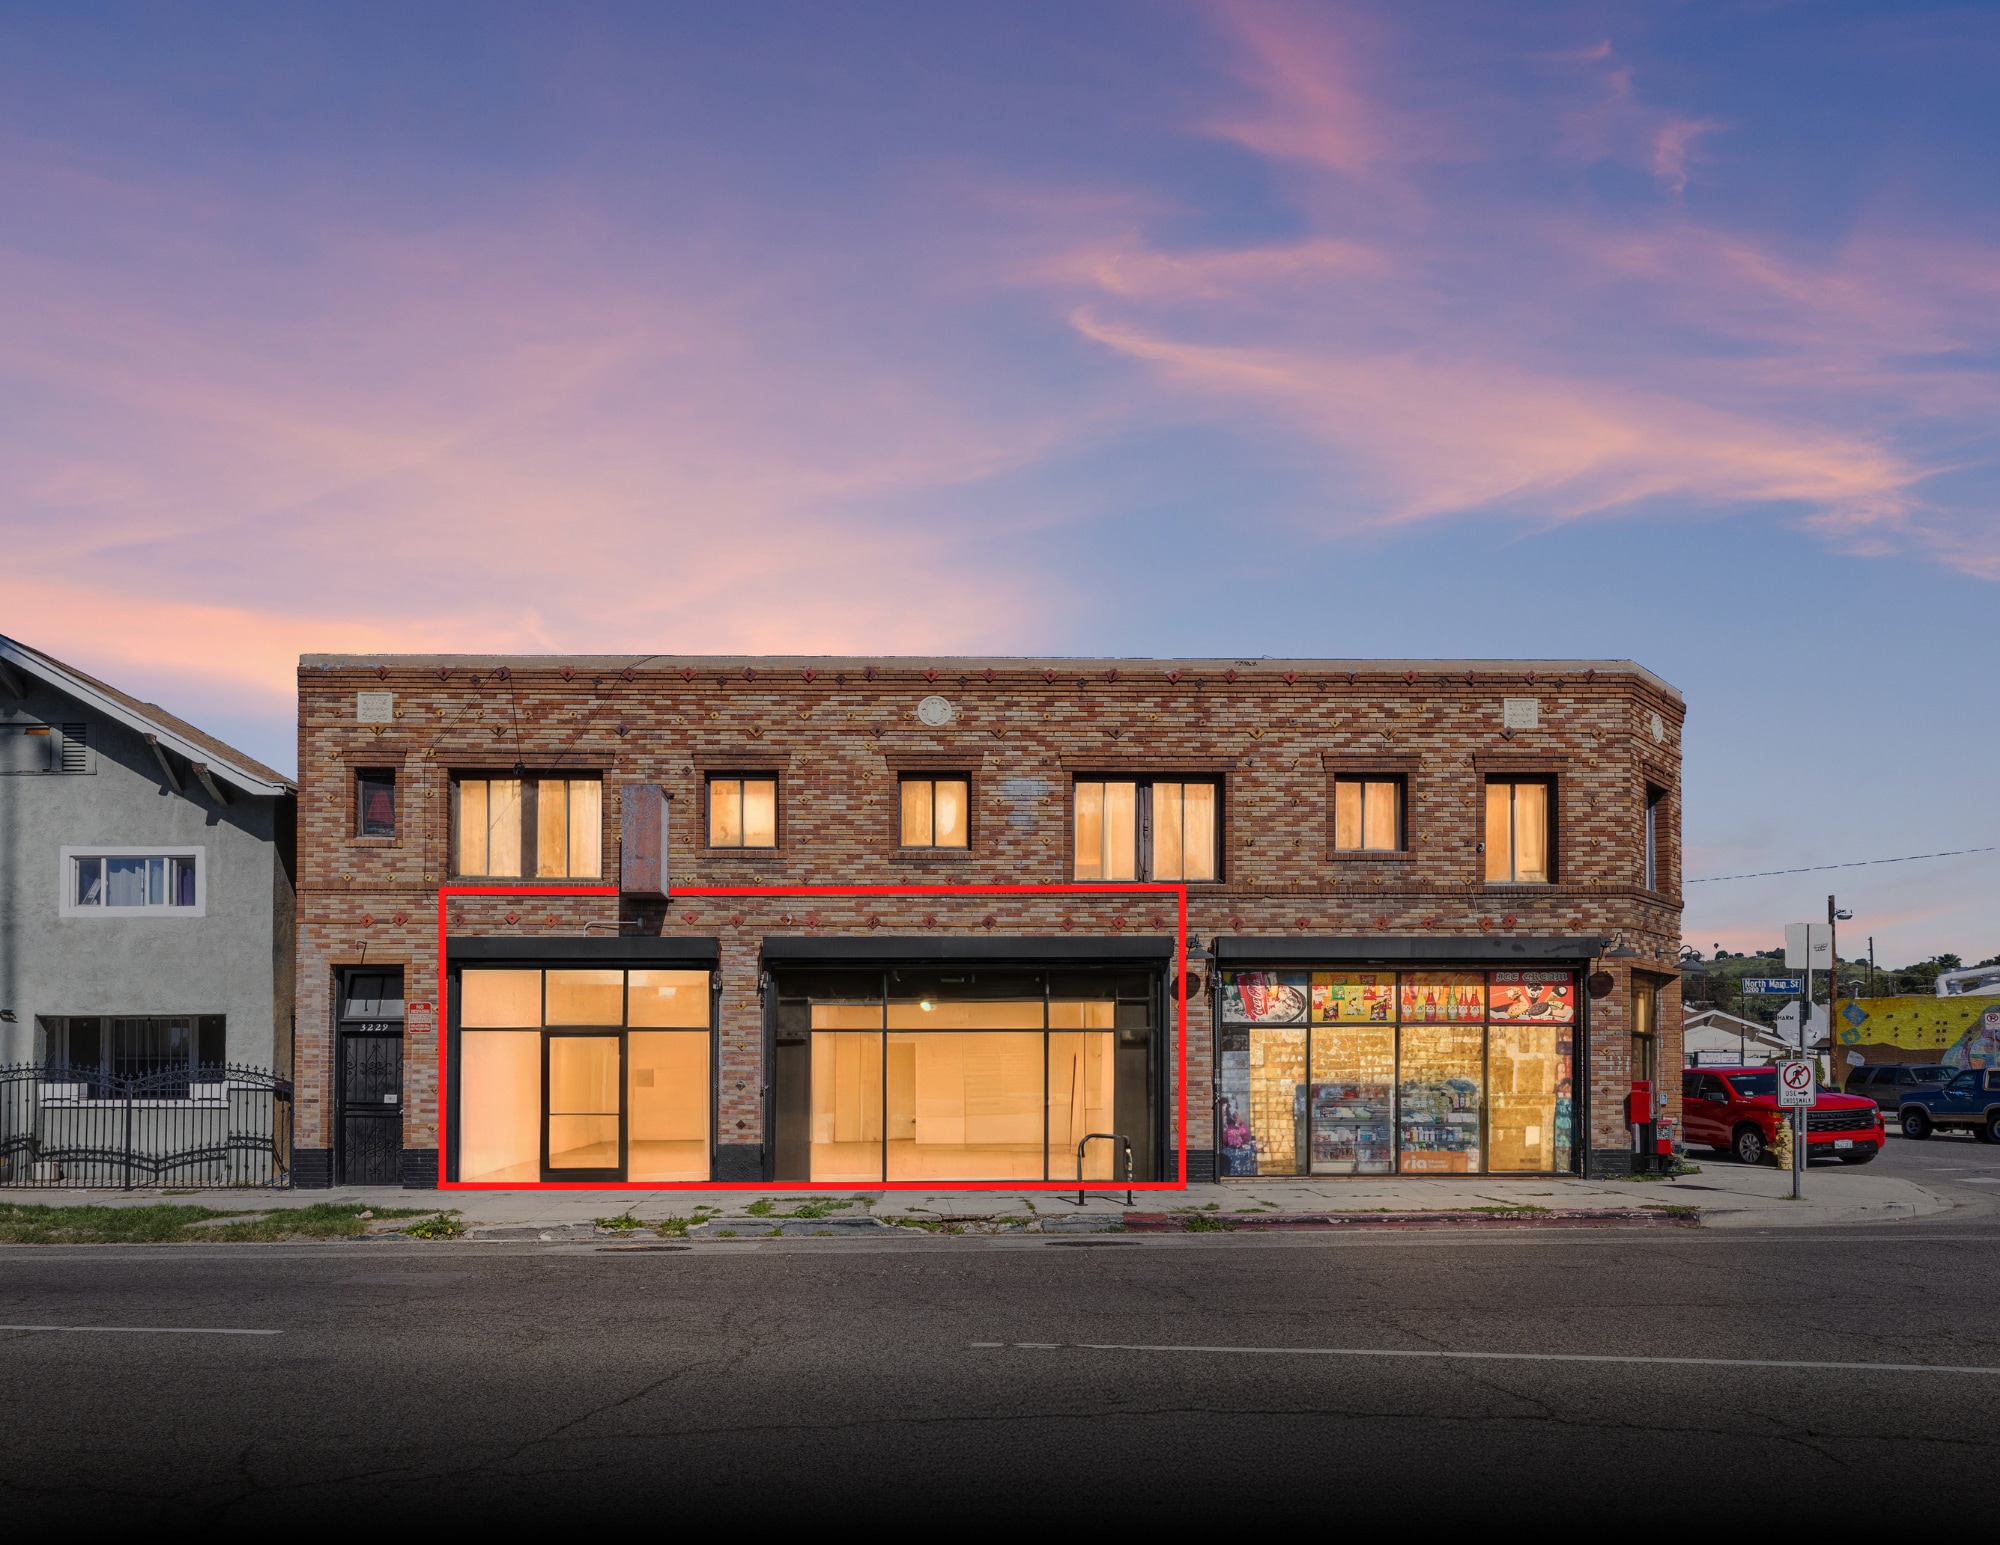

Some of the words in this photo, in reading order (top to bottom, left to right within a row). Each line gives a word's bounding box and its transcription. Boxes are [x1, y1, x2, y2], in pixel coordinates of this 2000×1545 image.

[1496, 972, 1519, 982] ICE
[1522, 972, 1568, 982] CREAM
[1745, 979, 1766, 988] North
[1769, 980, 1786, 989] Main
[1790, 980, 1799, 988] St
[360, 1023, 389, 1032] 3229
[1404, 1155, 1427, 1169] ria
